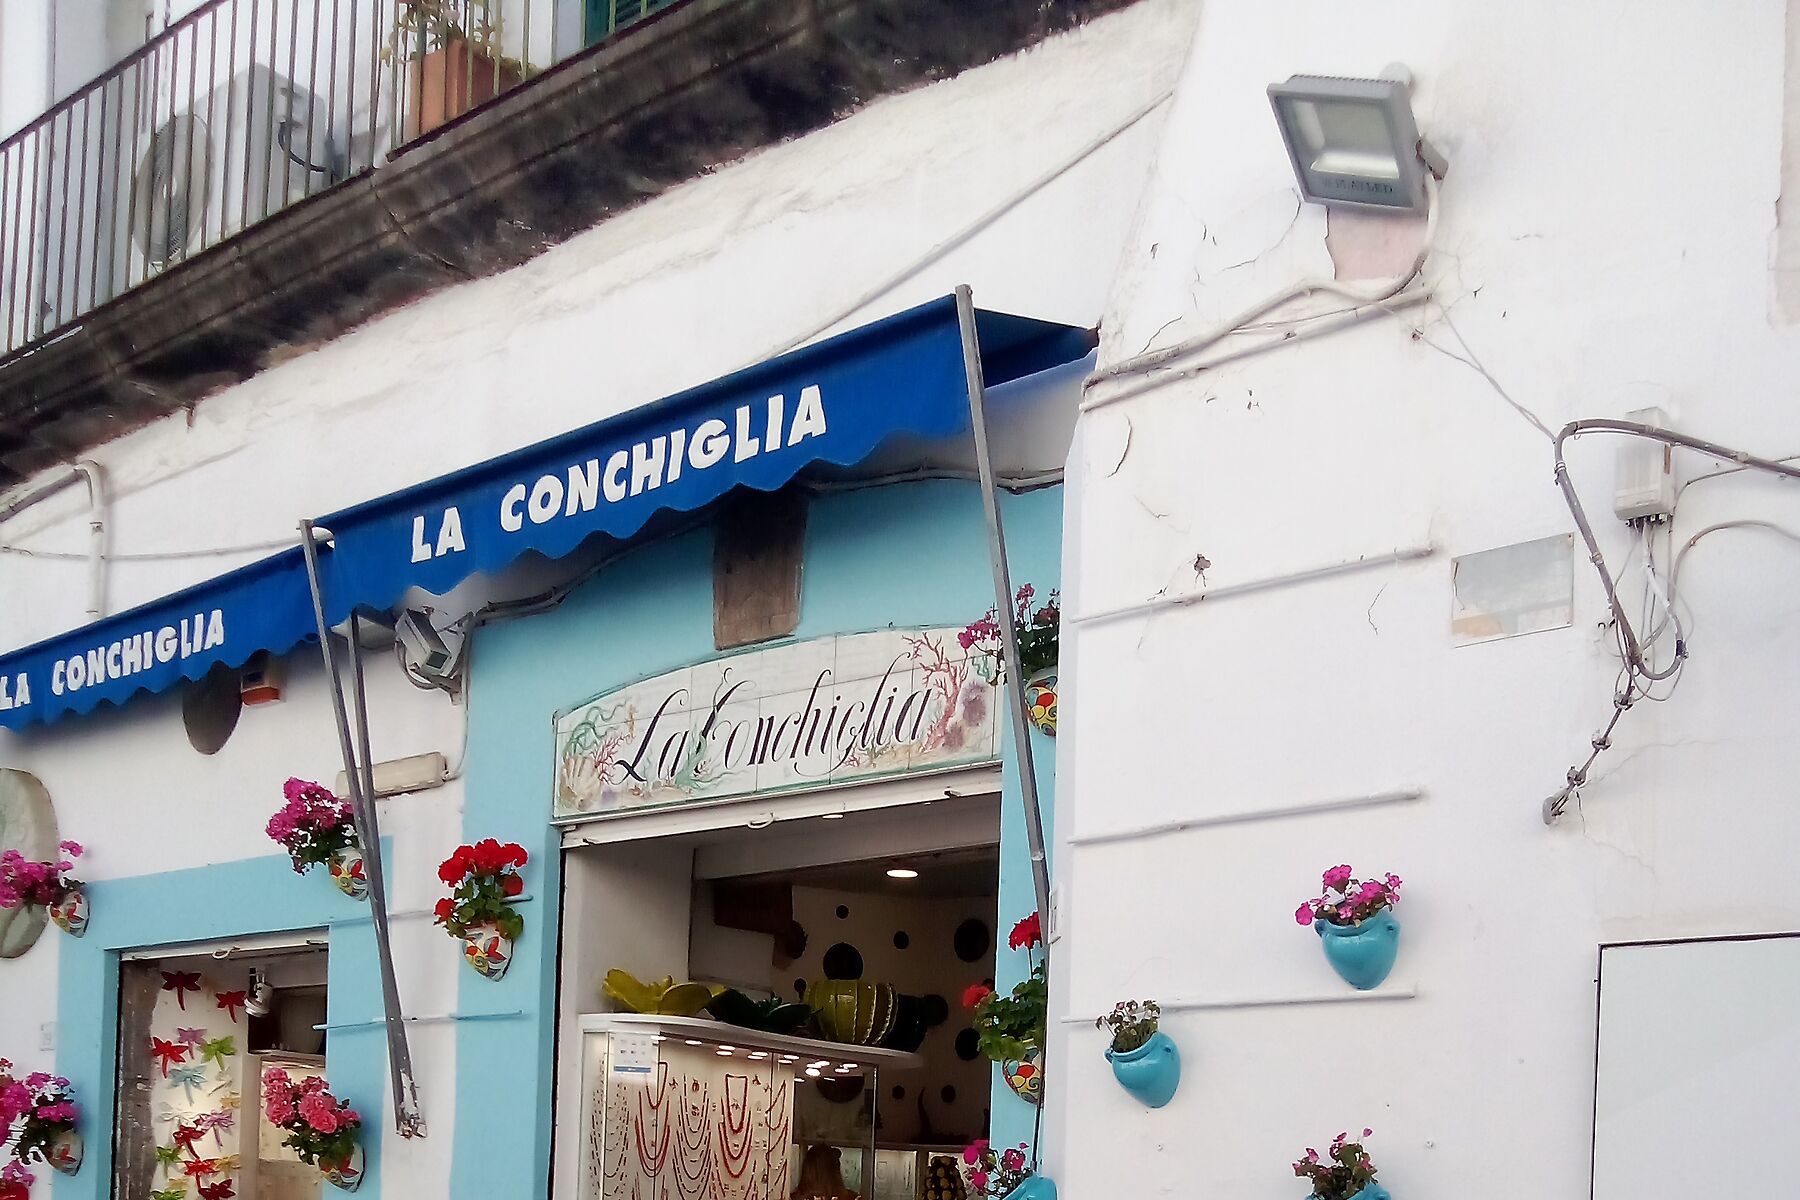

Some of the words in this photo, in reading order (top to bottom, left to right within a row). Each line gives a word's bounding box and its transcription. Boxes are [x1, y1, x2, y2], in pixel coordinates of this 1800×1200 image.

[411, 507, 466, 563] LA
[501, 384, 827, 532] CONCHIGLIA
[0, 672, 31, 710] LA
[51, 609, 225, 696] CONCHIGLIA
[614, 688, 690, 782] La
[692, 652, 932, 777] Conchiglia
